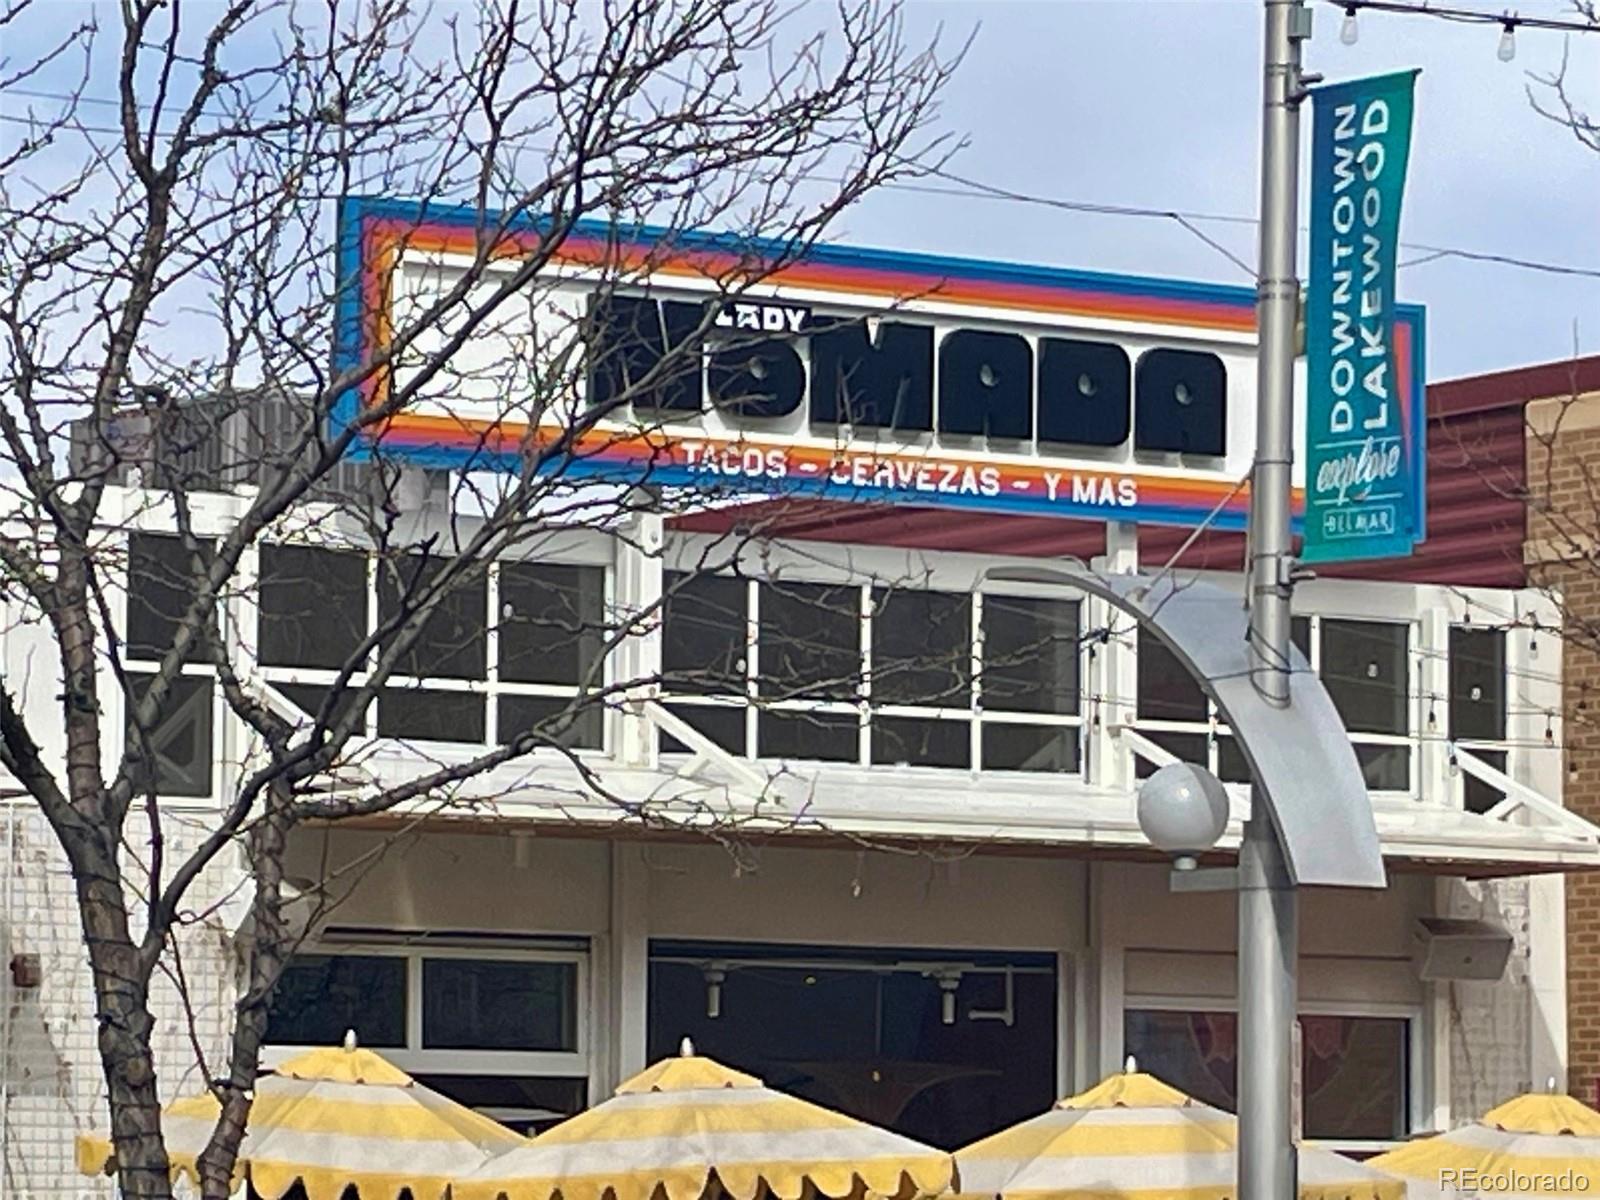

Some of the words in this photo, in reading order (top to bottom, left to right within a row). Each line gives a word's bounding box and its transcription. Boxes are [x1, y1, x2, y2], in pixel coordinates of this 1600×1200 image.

[714, 303, 806, 332] LADY
[1330, 103, 1358, 434] DOWNTOWN
[1358, 97, 1391, 430] LAKEWOOD
[586, 293, 1227, 456] NOMADA
[680, 441, 788, 479] TACOS
[829, 451, 1001, 497] CERVEZAS
[1043, 471, 1063, 501] Y
[1071, 475, 1138, 507] MAS
